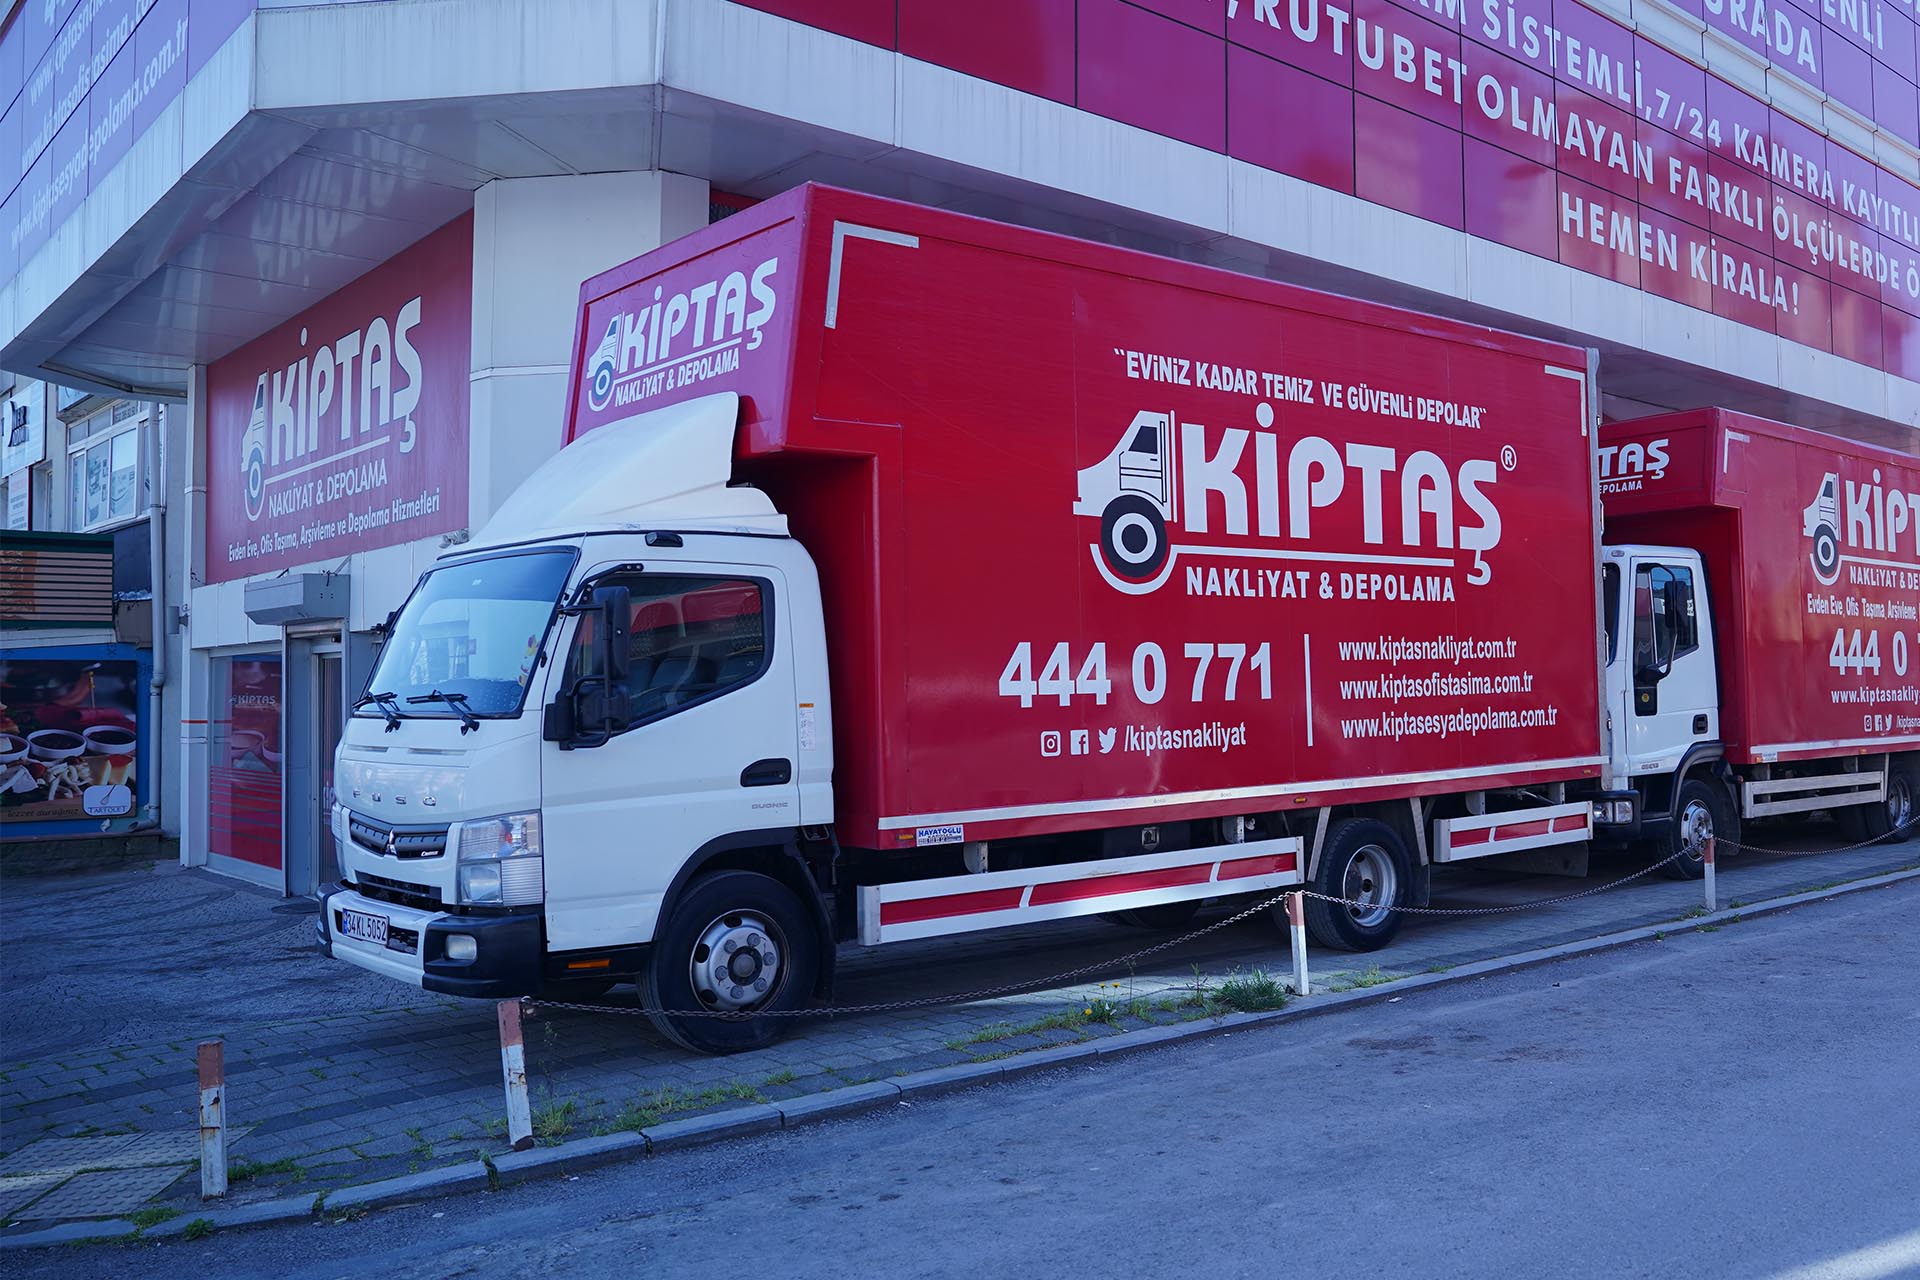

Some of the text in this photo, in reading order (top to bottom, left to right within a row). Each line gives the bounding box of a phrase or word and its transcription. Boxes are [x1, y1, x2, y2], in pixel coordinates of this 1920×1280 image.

[1477, 74, 1654, 185] OLMAYAN
[1669, 156, 1763, 232] FARKLI
[1772, 195, 1899, 290] ÖLÇÜLERDE
[1734, 123, 1836, 205] KAMERA
[1842, 179, 1919, 246] KAYITLI
[1561, 191, 1798, 315] HEMEN KİRALA!
[619, 257, 778, 374] KİPTAŞ
[271, 296, 422, 466] KİPTAŞ
[666, 370, 675, 391] &
[677, 348, 739, 388] DEPOLAMA
[1196, 361, 1257, 396] KADAR
[1322, 381, 1343, 408] VE
[316, 480, 324, 504] &
[327, 458, 388, 502] DEPOLAMA
[1181, 402, 1502, 586] KİPTAŞ
[229, 544, 246, 562] Evden
[261, 532, 273, 554] Ofis
[300, 523, 336, 549] Arşivleme
[337, 520, 346, 536] ve
[348, 508, 390, 537] Depolama
[392, 488, 440, 523] Hizmetleri
[1318, 572, 1334, 600] &
[1341, 573, 1455, 602] DEPOLAMA
[1807, 593, 1829, 614] Evden
[1846, 597, 1859, 616] Ofis
[1900, 572, 1906, 590] &
[1339, 635, 1517, 666] www.kiptasnakliyat.com.tr
[1829, 628, 1908, 677] 444 0
[999, 641, 1272, 708] 444 0 771
[1340, 671, 1533, 704] www.kiptasofistasima.com.tr
[1124, 721, 1246, 757] /kiptasnakliyat
[1341, 704, 1558, 742] www.kiptasesyadepolama.com.tr
